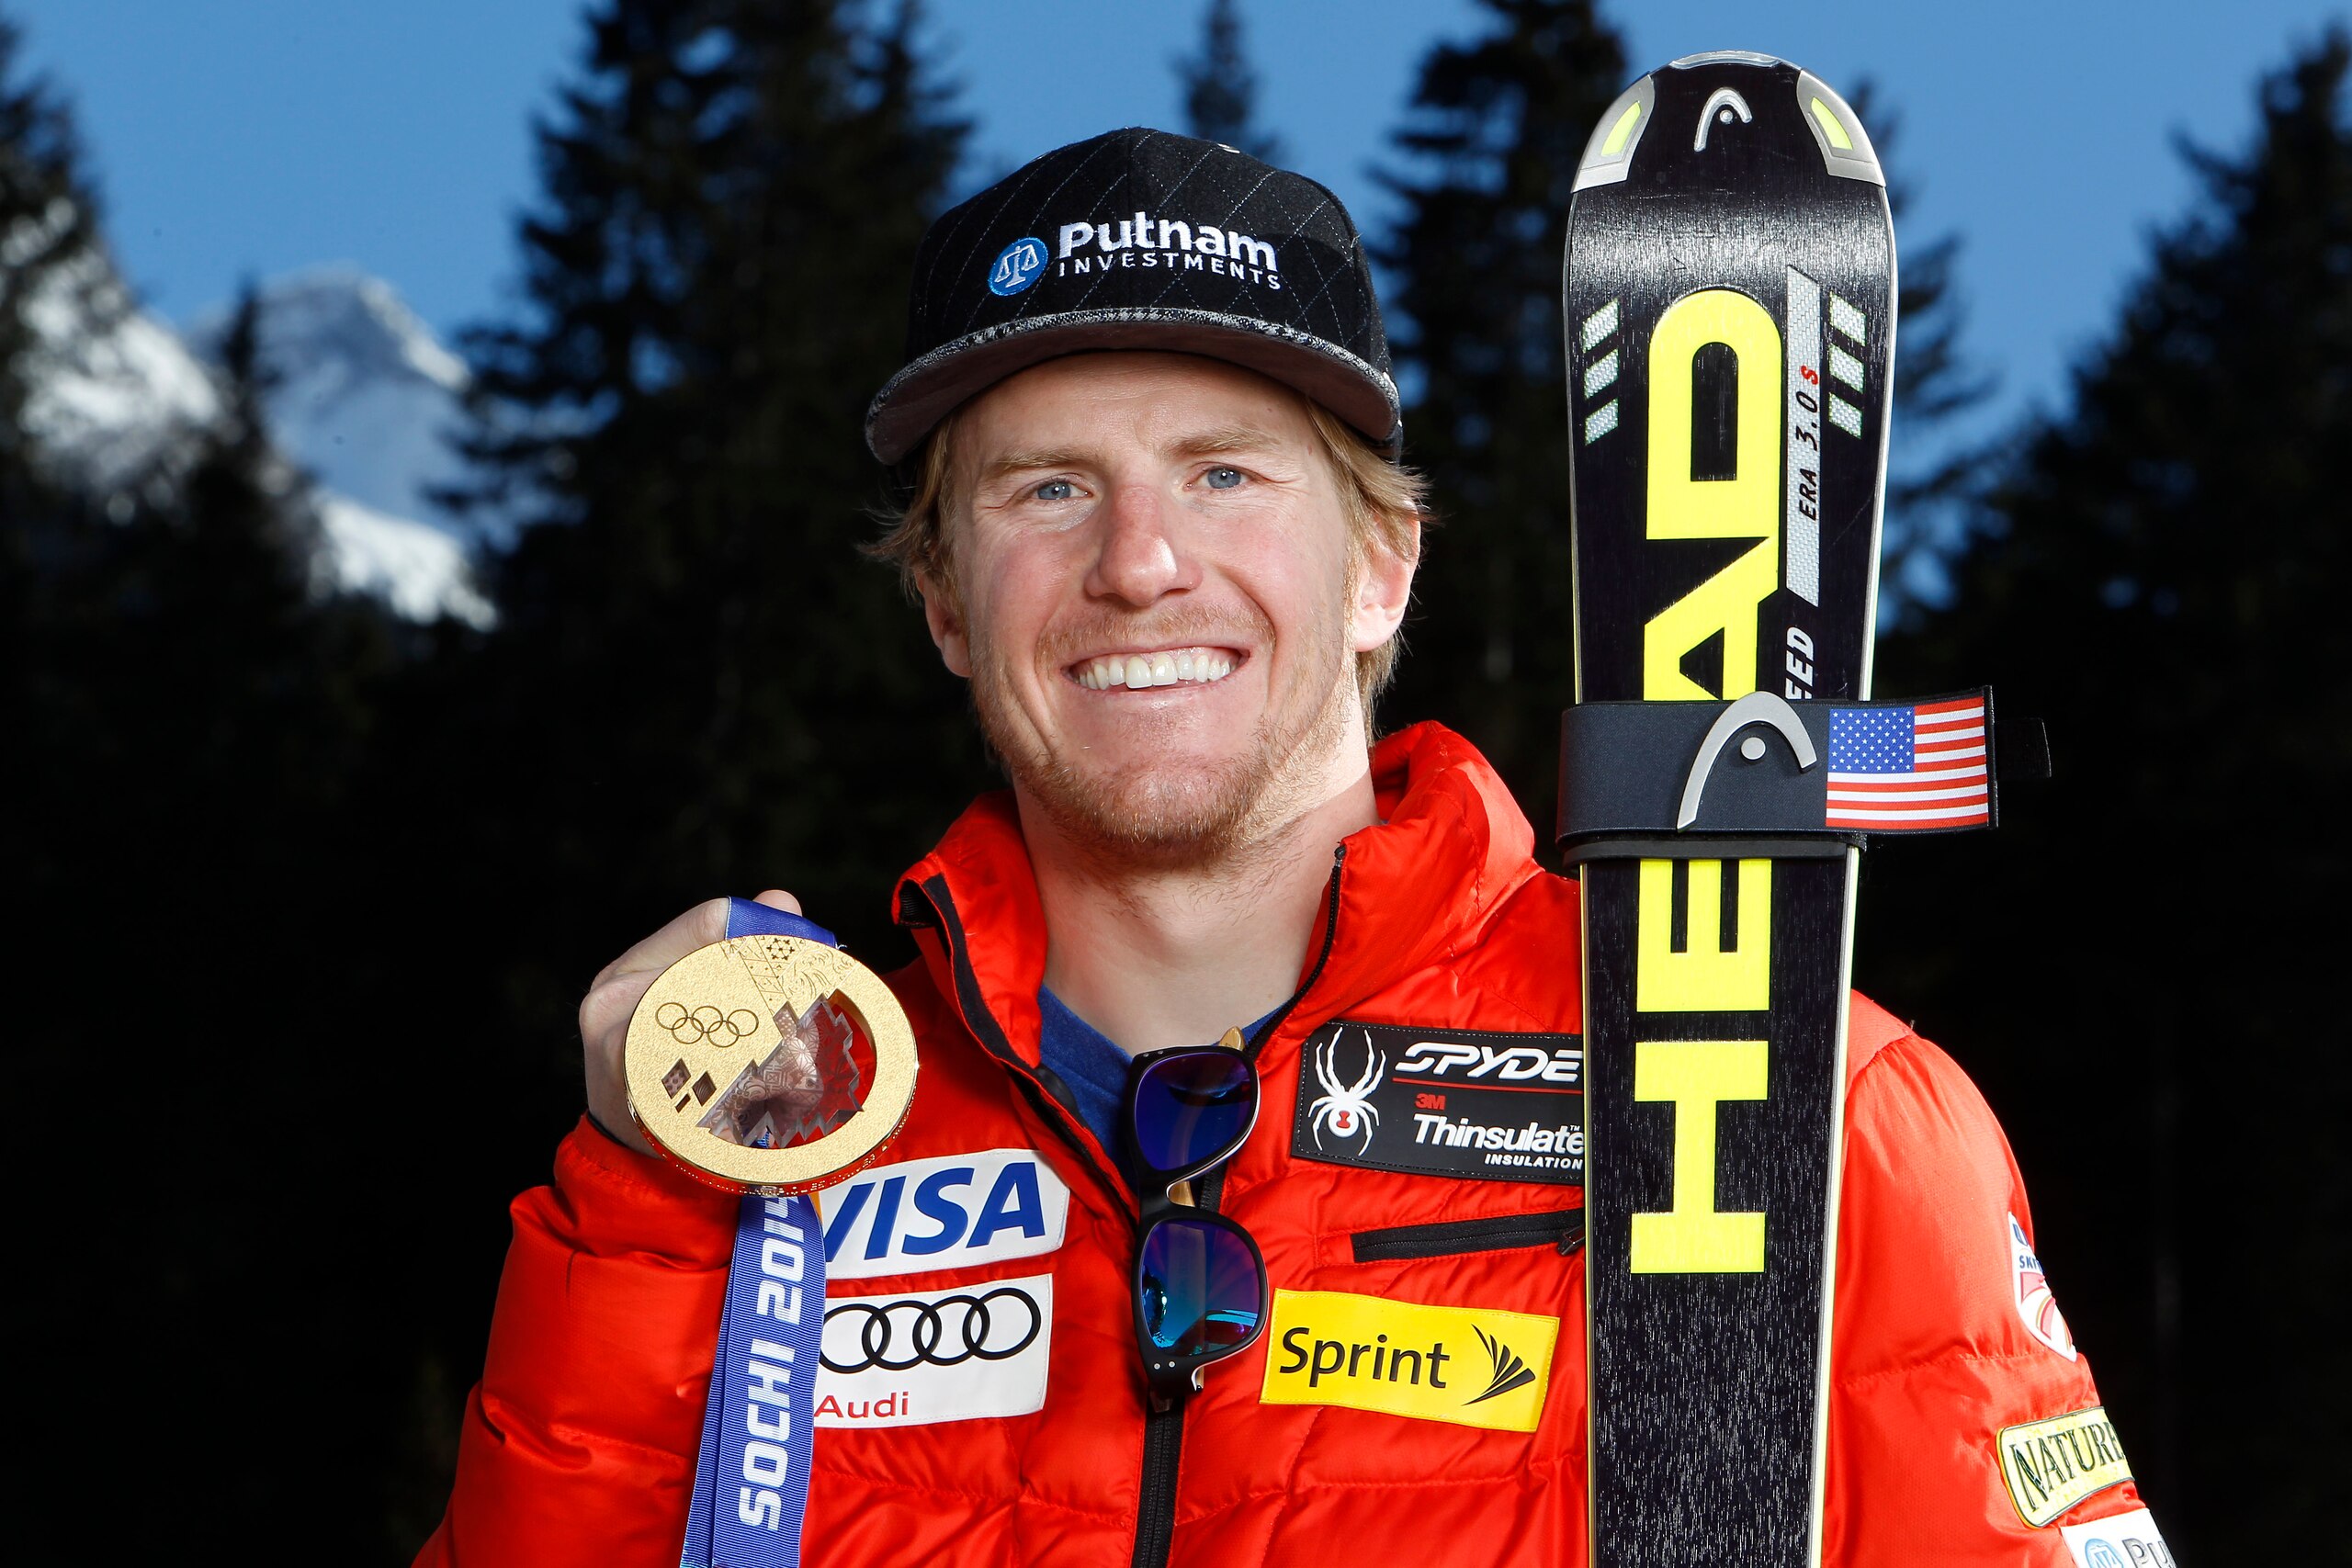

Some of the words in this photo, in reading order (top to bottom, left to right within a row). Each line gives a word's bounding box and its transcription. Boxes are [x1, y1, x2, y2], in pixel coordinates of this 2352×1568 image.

[1058, 210, 1279, 272] Putnam
[1058, 252, 1282, 291] INVESTMENTS
[1795, 389, 1819, 452] 3.0
[1798, 468, 1818, 522] ERA
[1630, 288, 1783, 1274] HEAD
[1415, 1093, 1446, 1111] 3M
[1485, 1153, 1584, 1170] INSULATION
[1279, 1326, 1451, 1389] Sprint
[814, 1390, 910, 1419] Audi
[738, 1337, 797, 1532] SOCHI
